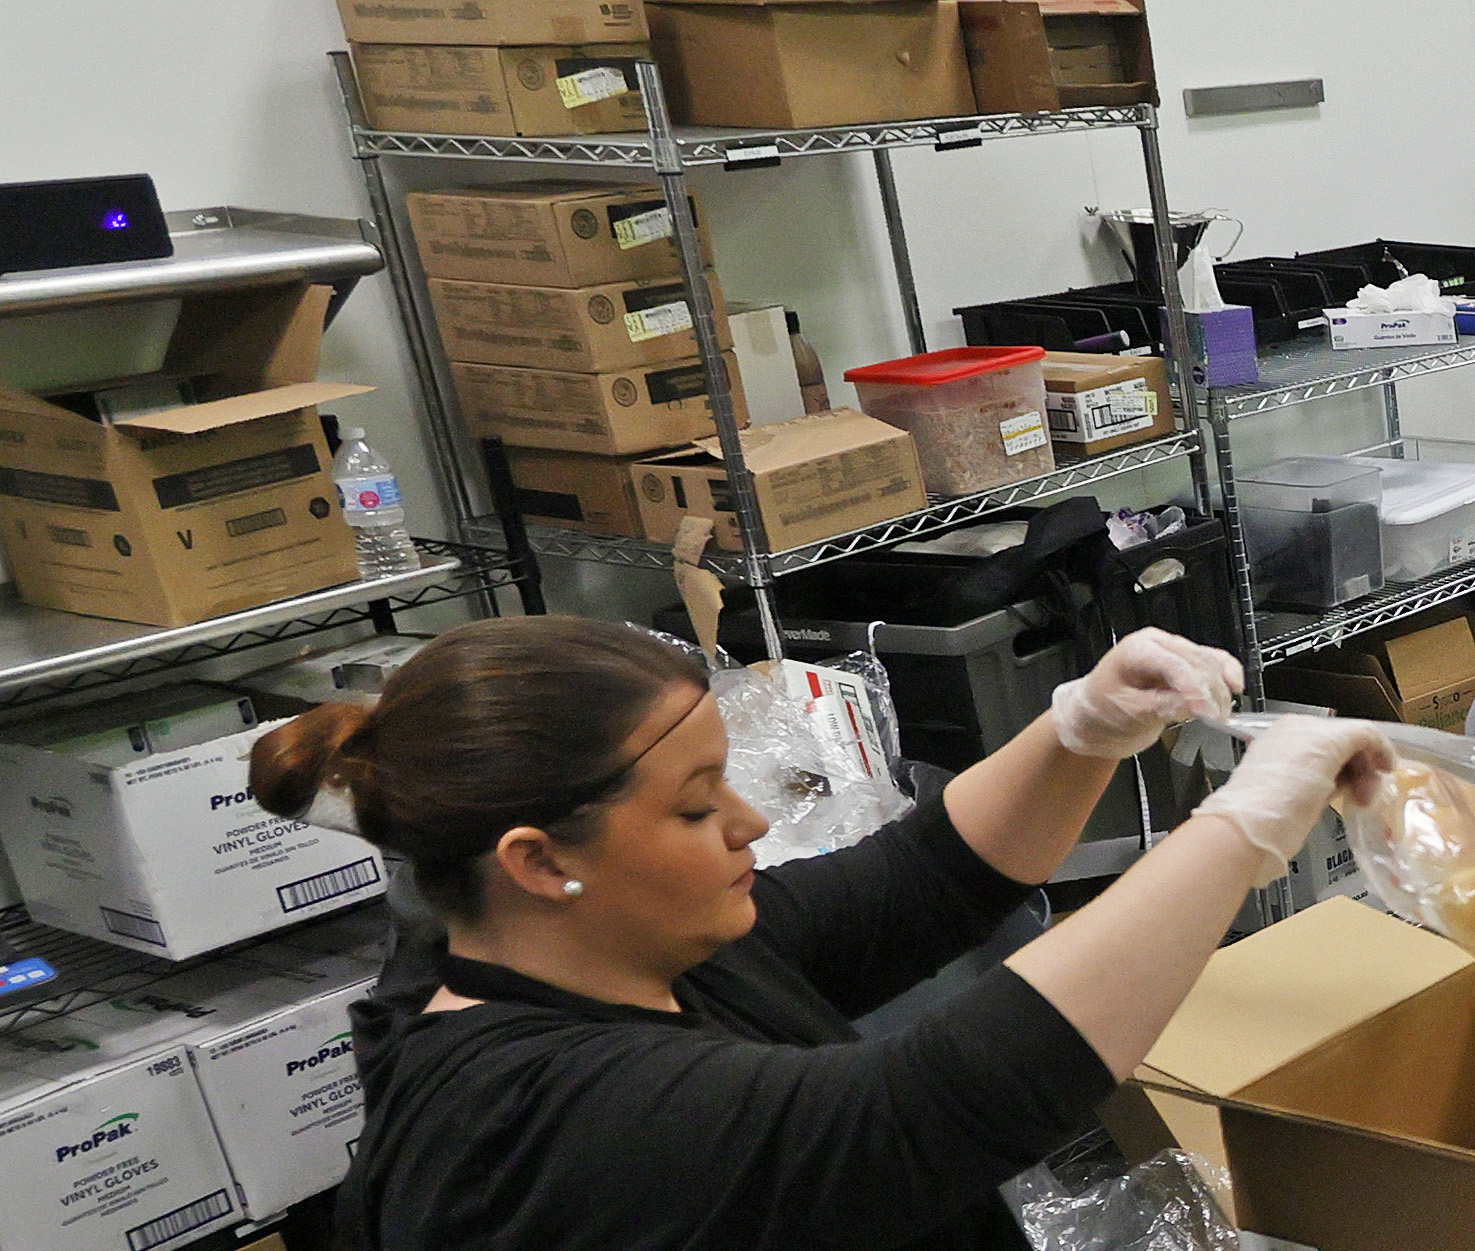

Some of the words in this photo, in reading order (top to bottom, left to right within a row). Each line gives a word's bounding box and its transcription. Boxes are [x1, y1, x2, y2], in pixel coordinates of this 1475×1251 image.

[212, 836, 253, 856] VINYL
[256, 820, 311, 844] GLOVES
[286, 1039, 353, 1077] ProPak
[289, 1097, 328, 1118] VINYL
[328, 1083, 362, 1102] GLOV
[56, 1122, 132, 1163] ProPak
[60, 1185, 104, 1207] VINYL
[104, 1158, 160, 1189] GLOVES
